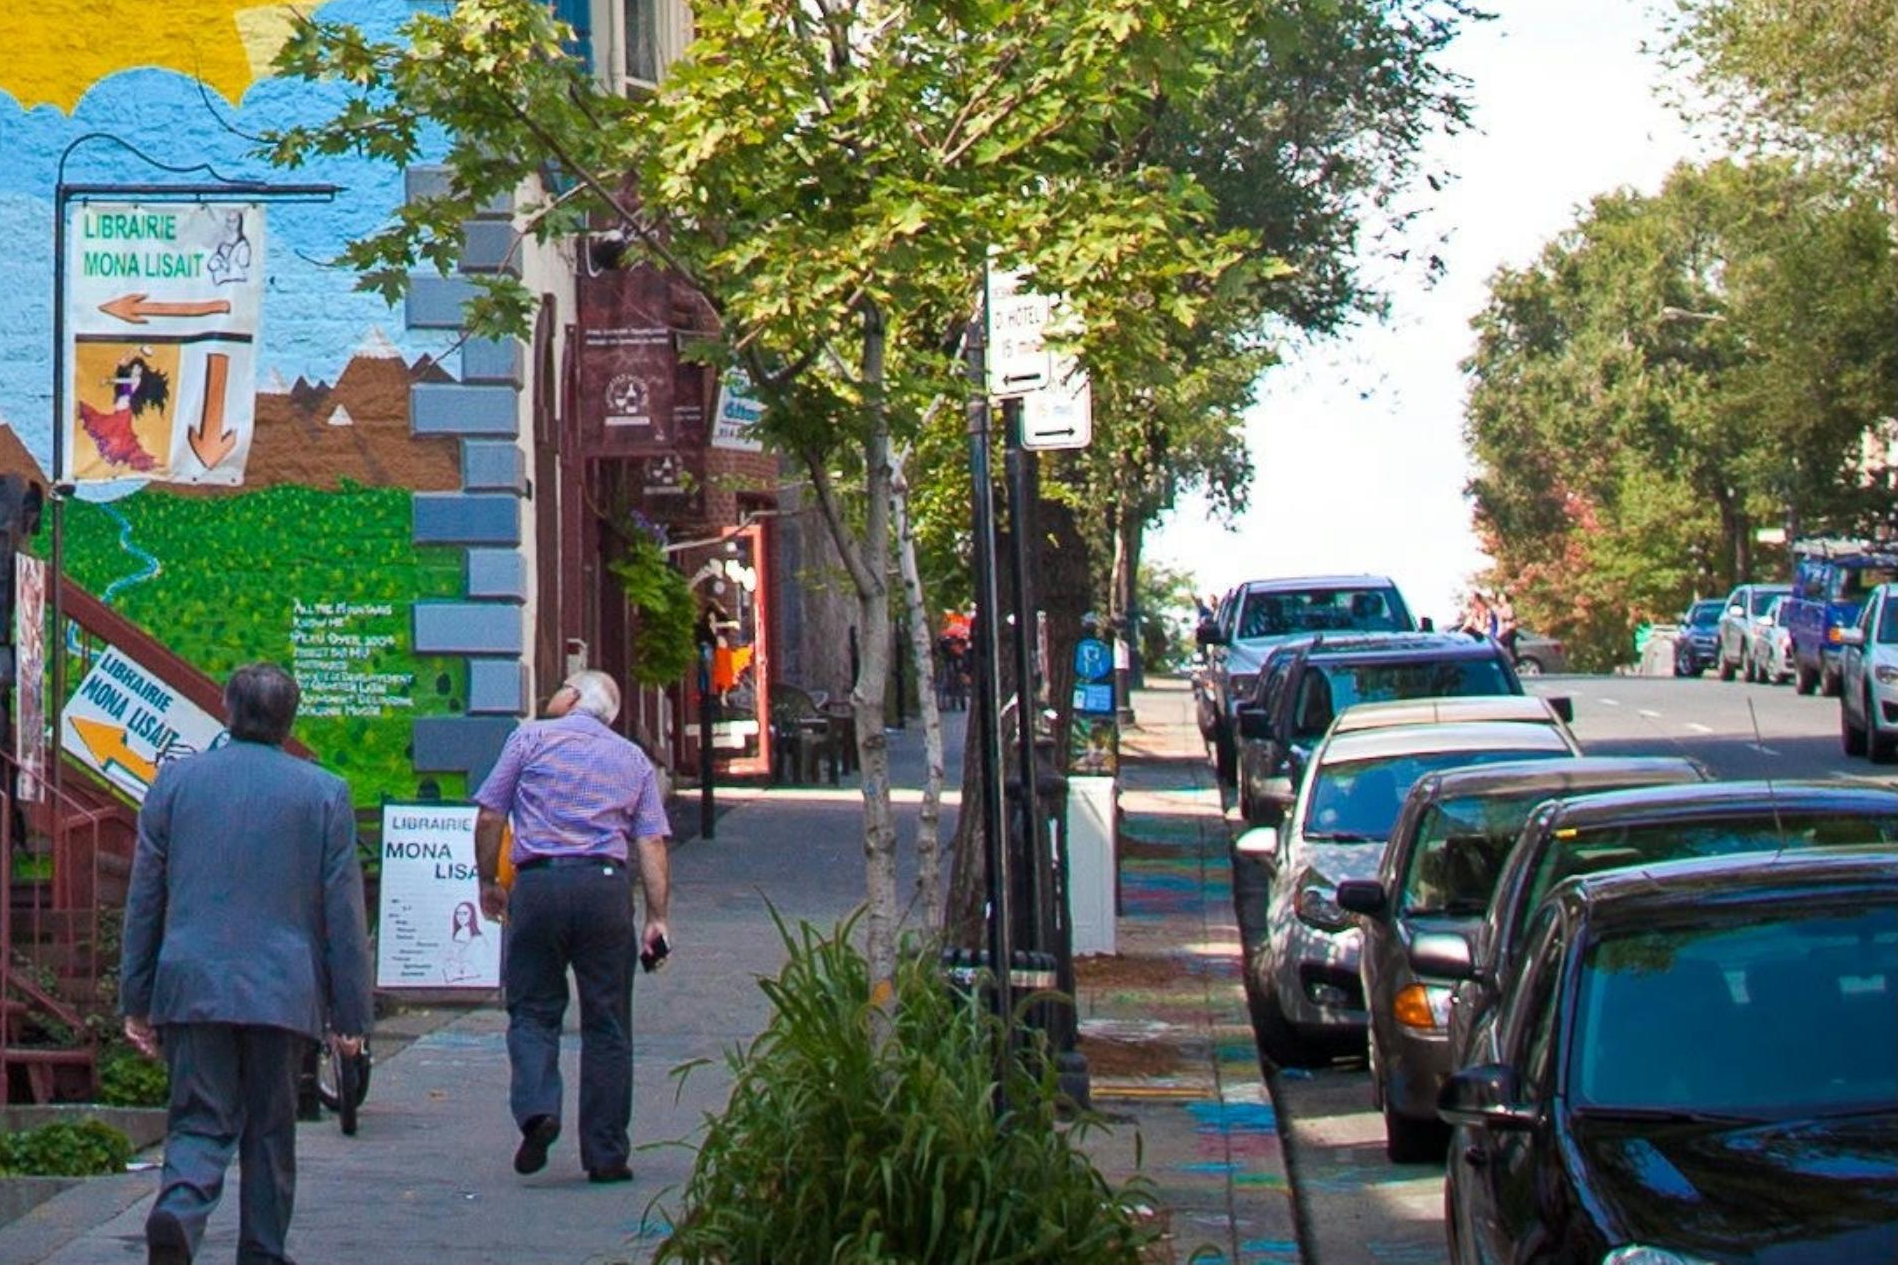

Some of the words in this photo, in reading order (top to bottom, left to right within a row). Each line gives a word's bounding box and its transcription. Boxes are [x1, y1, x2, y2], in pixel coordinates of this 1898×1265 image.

[84, 214, 176, 240] LIBRAIRIE
[84, 252, 139, 278] MONA
[146, 252, 204, 278] LISAIT
[100, 653, 174, 713] LIBRAIRIE
[81, 674, 129, 721] MONA
[392, 816, 472, 831] LIBRAIRIE
[386, 842, 452, 860] MONA
